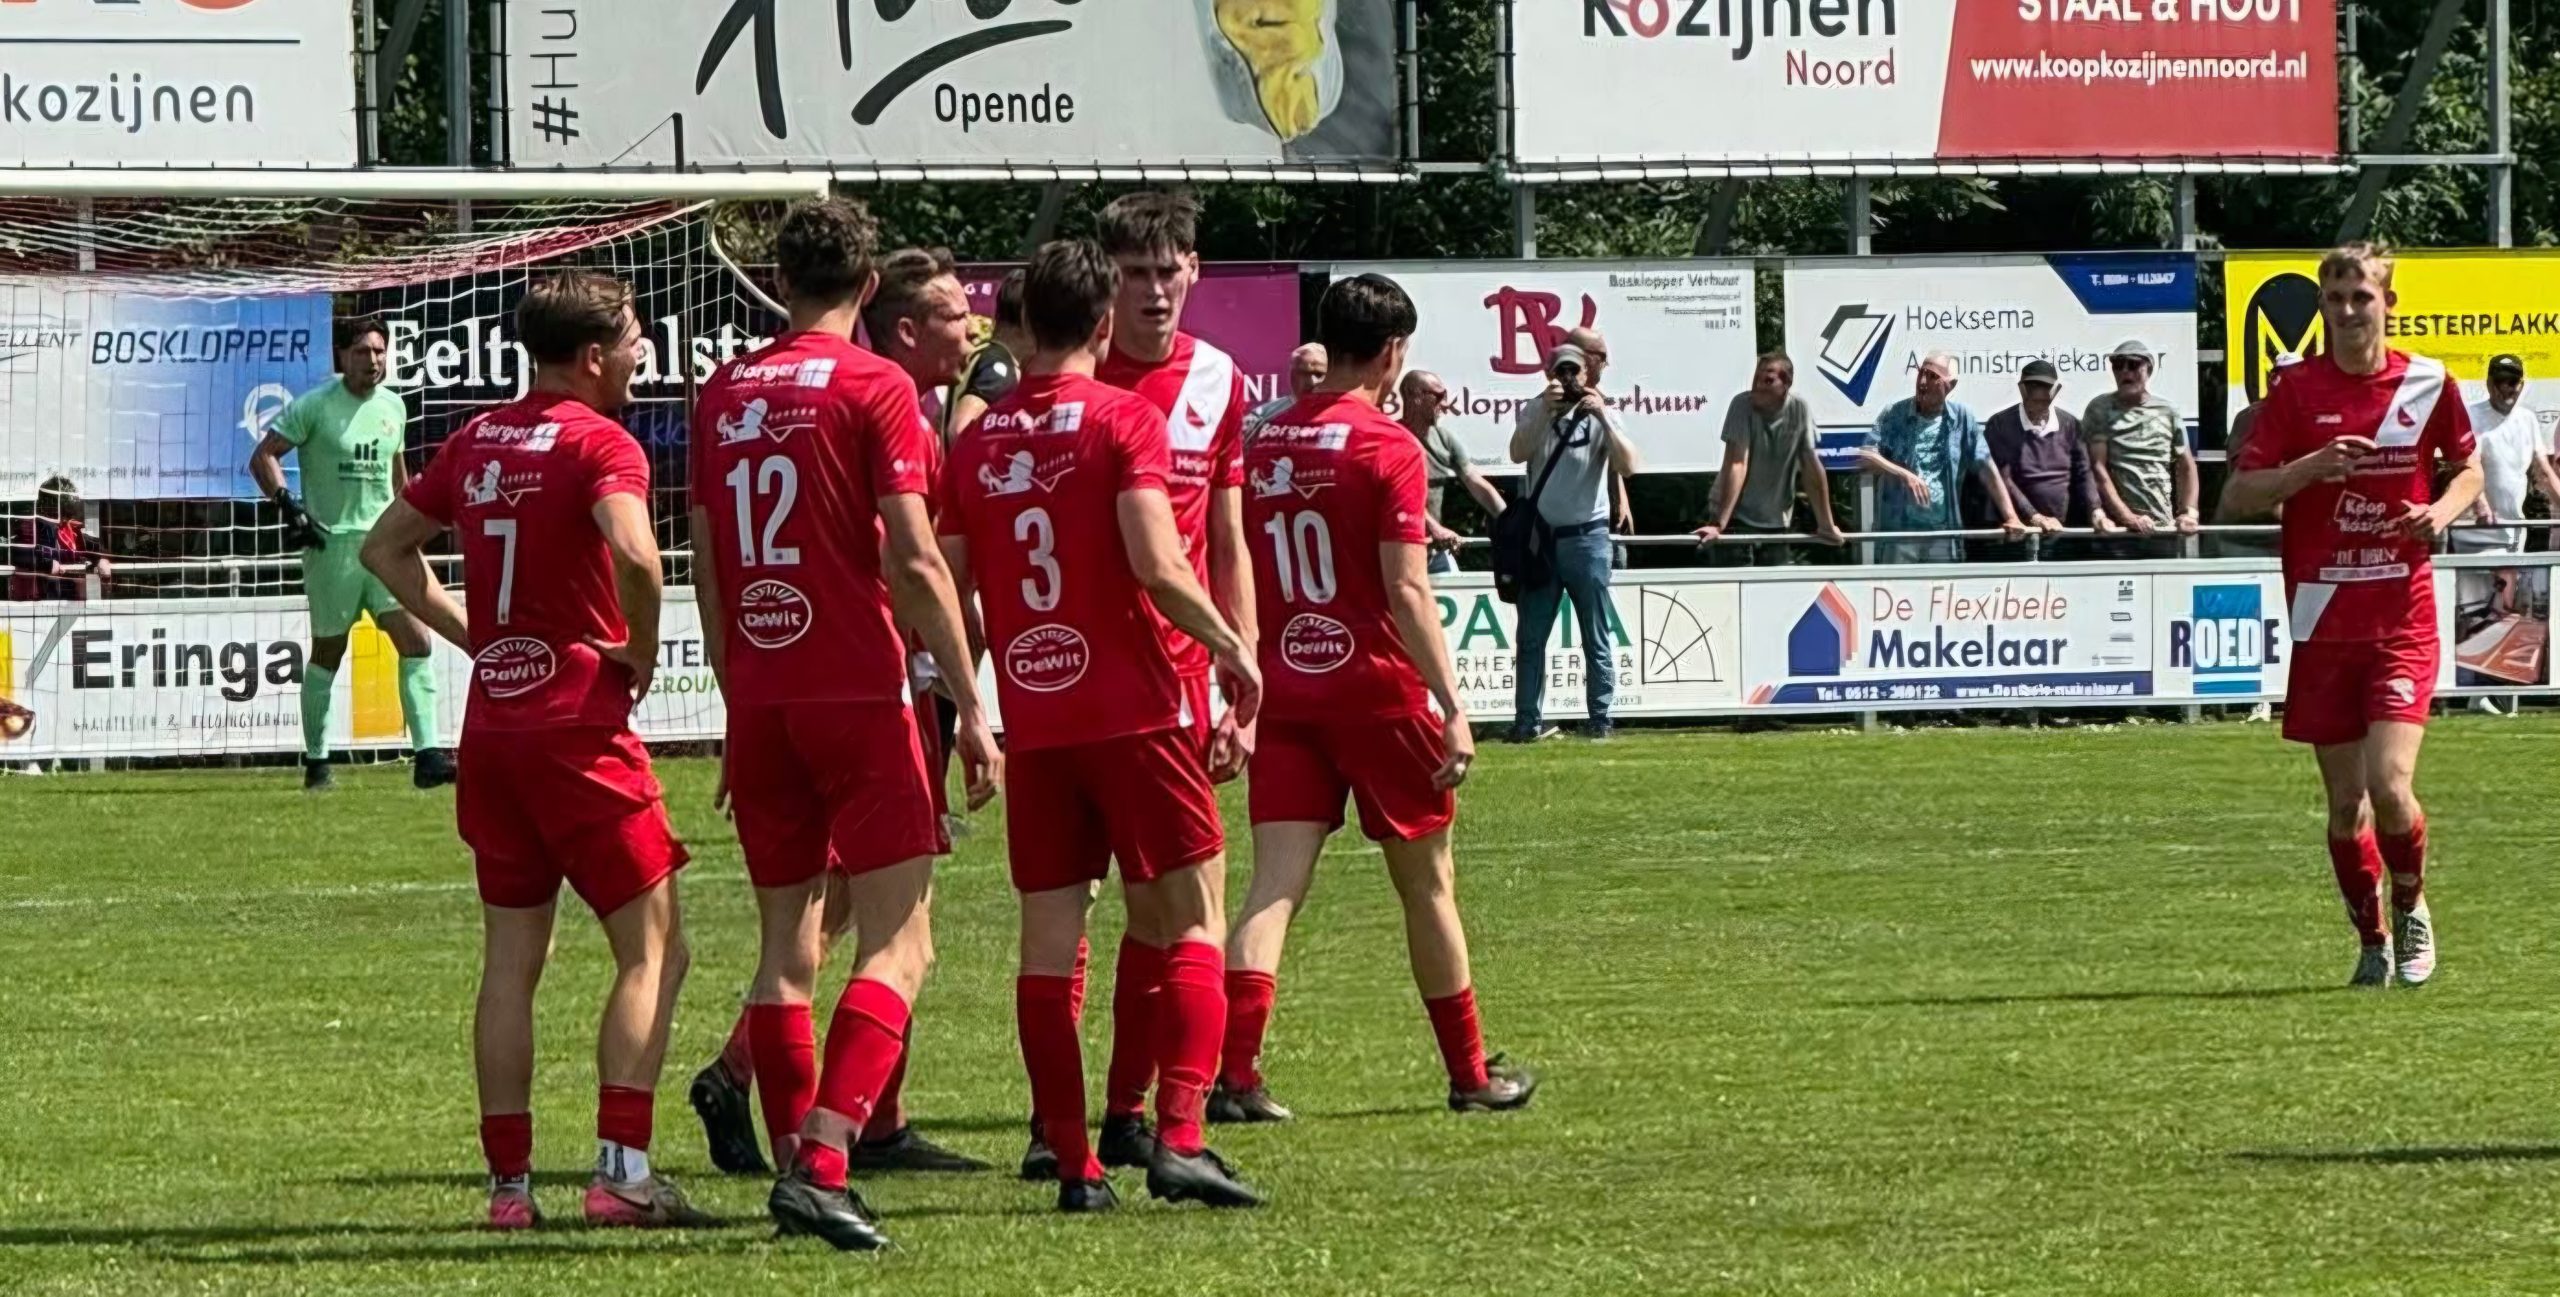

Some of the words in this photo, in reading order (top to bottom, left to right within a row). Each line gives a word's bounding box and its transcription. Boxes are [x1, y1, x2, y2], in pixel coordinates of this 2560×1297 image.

[1786, 47, 1896, 86] Noord
[1971, 50, 2307, 85] www.koopkozijnennoord.nl
[3, 73, 253, 133] kozijnen
[934, 83, 1075, 132] Opende
[1907, 305, 2034, 330] Hoeksema
[2385, 313, 2559, 336] EESTERPLAKK
[92, 329, 311, 365] BOSKLOPPER
[726, 455, 800, 567] 12
[484, 519, 517, 625] 7
[1014, 507, 1062, 612] 3
[1264, 510, 1337, 603] 10
[1872, 587, 1914, 621] De
[1929, 582, 2067, 619] Flexibele
[72, 628, 304, 702] Eringa
[1869, 625, 2068, 668] Makelaar
[2170, 618, 2280, 668] ROEDE
